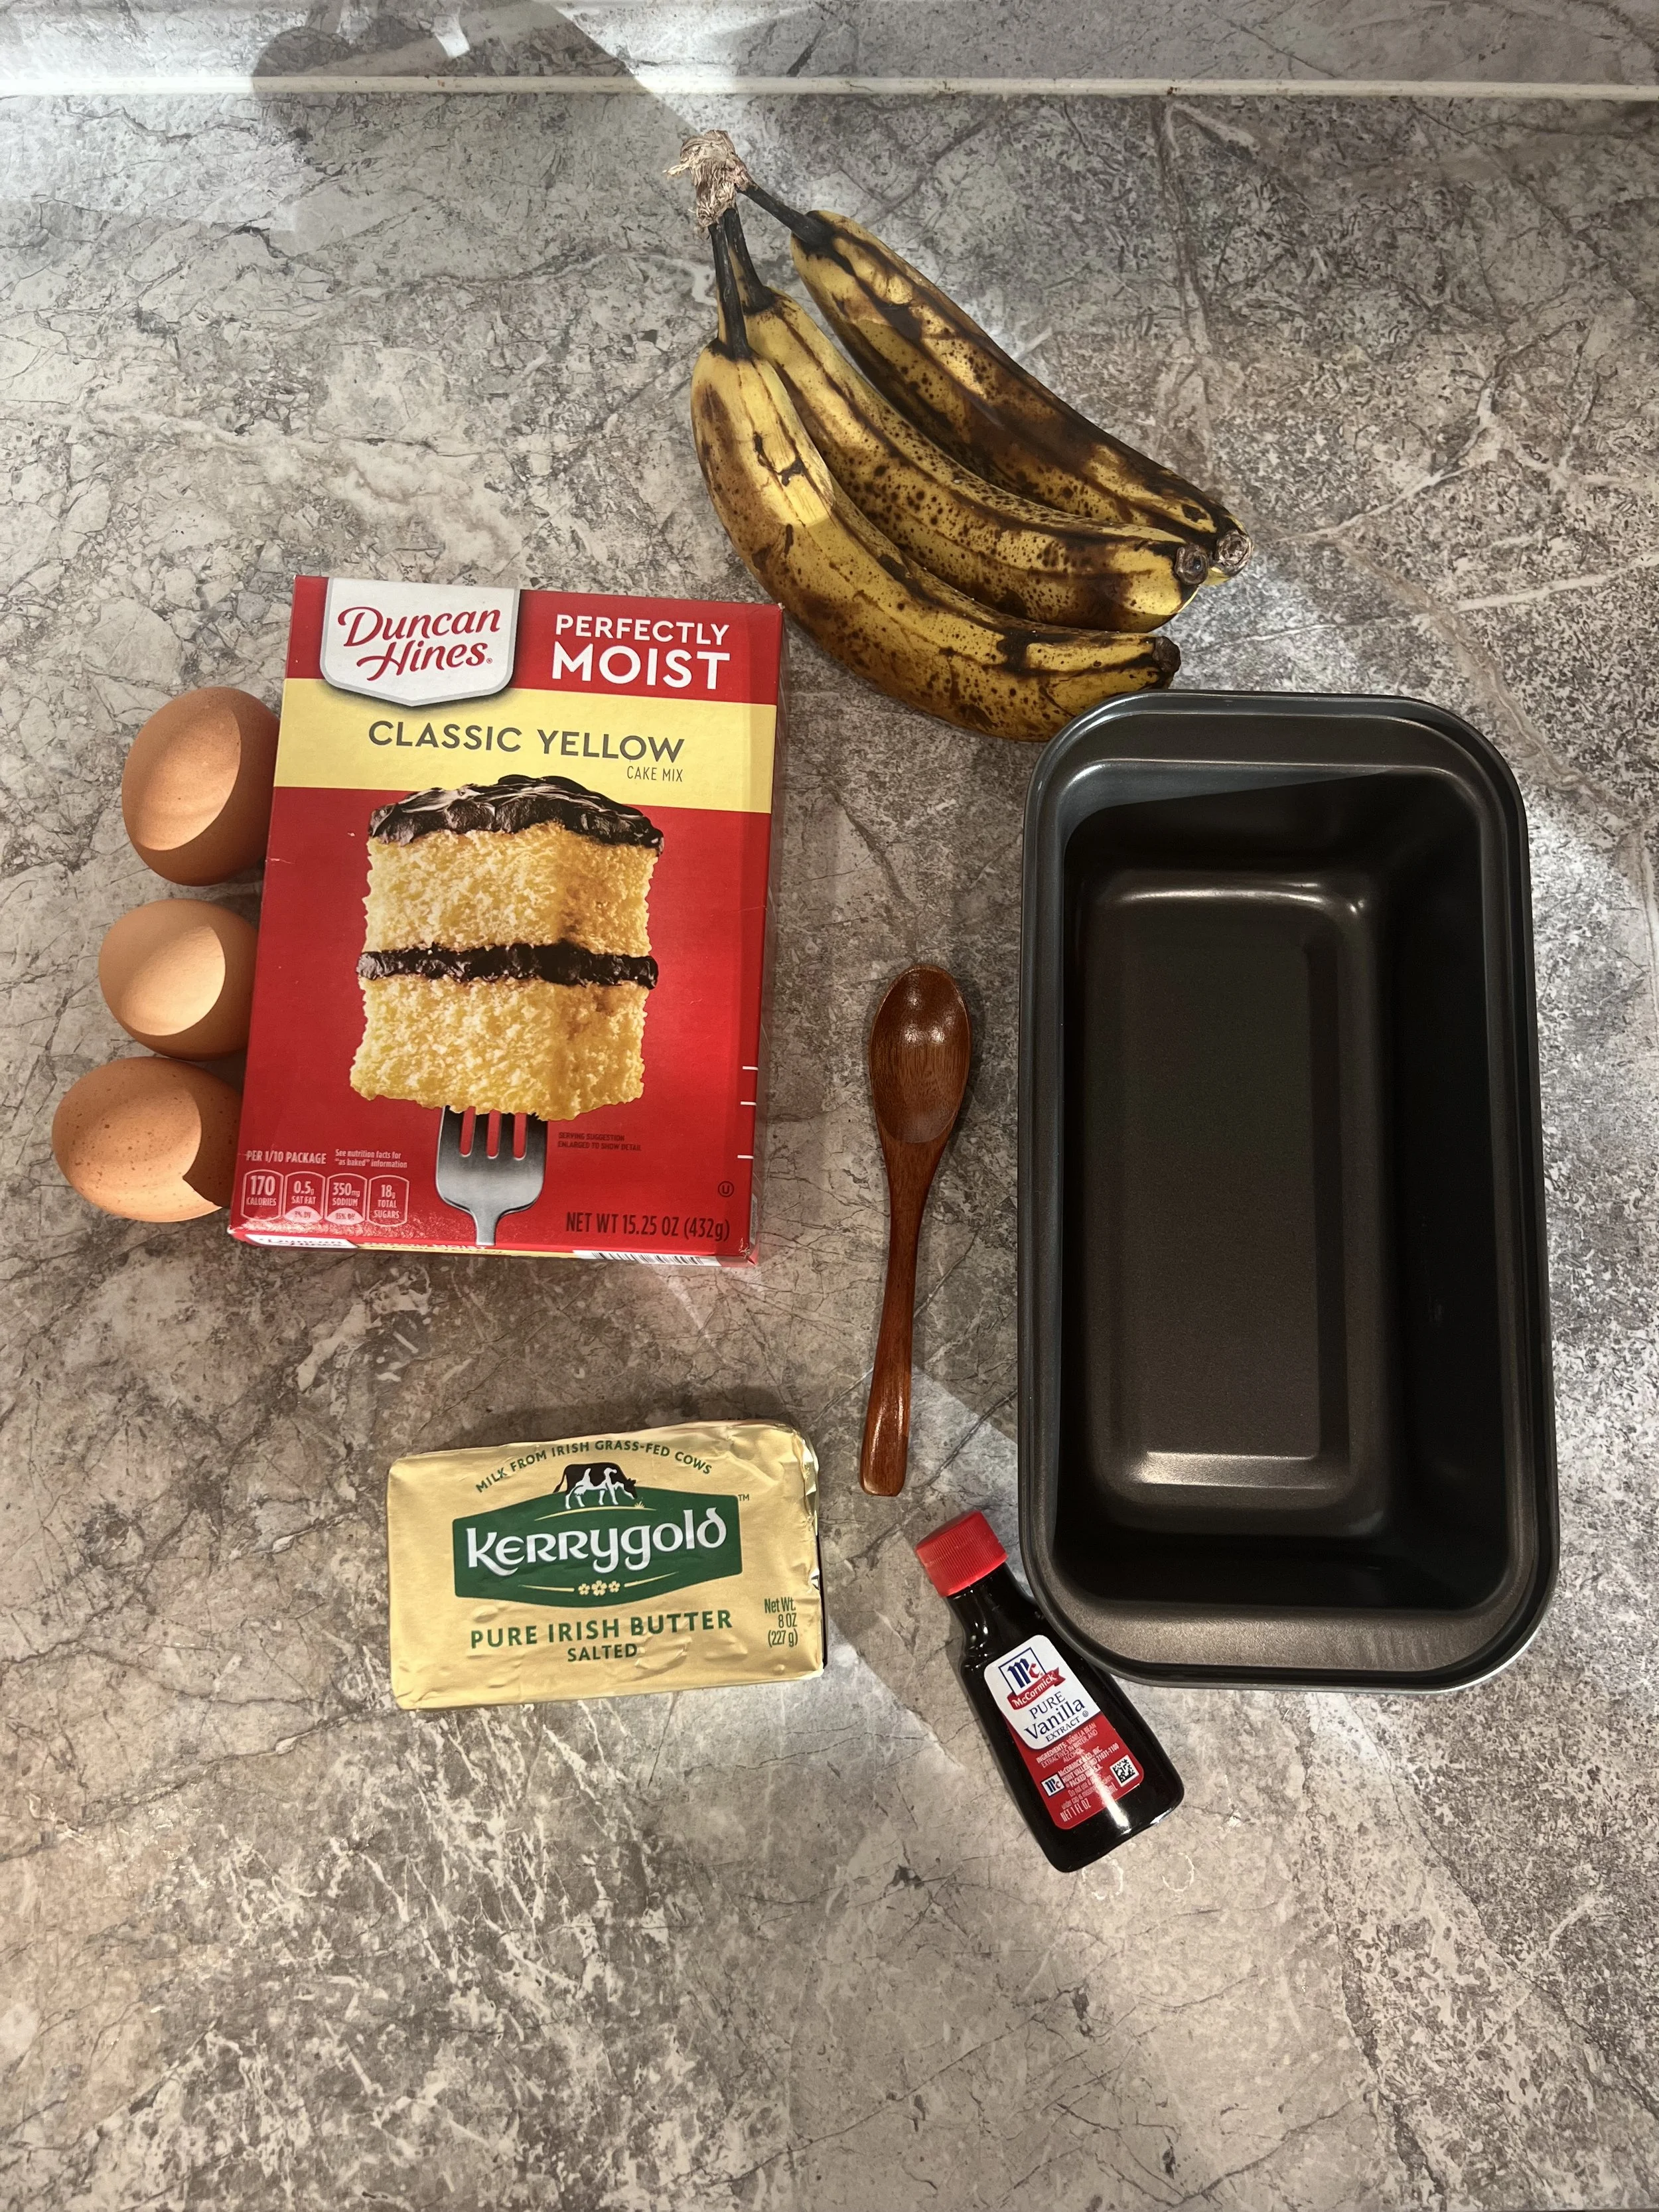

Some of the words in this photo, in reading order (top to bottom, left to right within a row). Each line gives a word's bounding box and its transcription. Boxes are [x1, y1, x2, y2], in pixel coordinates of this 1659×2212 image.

[337, 605, 501, 647] Duncan
[555, 614, 729, 645] PERFECTLY
[552, 640, 729, 690] MOIST
[368, 720, 522, 752] CLASSIC
[537, 729, 685, 763] YELLOW
[627, 765, 658, 781] CAKE
[662, 767, 683, 783] MIX
[246, 1150, 263, 1161] PER
[265, 1151, 283, 1163] 1/10
[285, 1151, 326, 1164] PACKAGE
[347, 1149, 375, 1158] nutrition
[371, 1159, 407, 1168] information
[250, 1175, 275, 1196] 170
[246, 1197, 277, 1206] CALORIES
[332, 1198, 358, 1207] SODIUM
[378, 1199, 397, 1208] TOTAL
[373, 1210, 399, 1219] SUGARS
[566, 1212, 592, 1232] NET
[597, 1213, 618, 1233] WT
[622, 1215, 657, 1235] 15.25
[661, 1216, 679, 1236] OZ
[684, 1217, 729, 1242] (432g)
[476, 1466, 507, 1493] MILK
[510, 1449, 547, 1473] FROM
[551, 1441, 590, 1457] IRISH
[595, 1440, 670, 1457] GRASS-FED
[675, 1451, 712, 1475] COWS
[764, 1598, 780, 1613] Net
[781, 1597, 796, 1612] Wt.
[471, 1625, 538, 1649] PURE
[549, 1618, 619, 1643] IRISH
[630, 1609, 733, 1637] BUTTER
[778, 1613, 784, 1628] 8
[786, 1613, 798, 1628] OZ
[768, 1629, 786, 1648] (227
[788, 1628, 798, 1647] g)
[567, 1643, 638, 1662] SALTED
[1011, 1672, 1056, 1708] McCormick
[1029, 1691, 1066, 1720] PURE
[1024, 1698, 1086, 1739] Vanilla
[1045, 1716, 1080, 1742] EXTRACT
[1036, 1741, 1067, 1763] INGREDIENTS:
[1066, 1730, 1084, 1743] VANILLA
[1084, 1722, 1096, 1733] BEAN
[1041, 1748, 1068, 1767] EXTRACTIVES
[1088, 1730, 1098, 1738] AND
[1062, 1772, 1074, 1783] HUNT
[1069, 1773, 1086, 1787] PACKED
[1060, 1808, 1073, 1822] NET
[1074, 1802, 1084, 1813] FL
[1081, 1798, 1091, 1809] OZ
